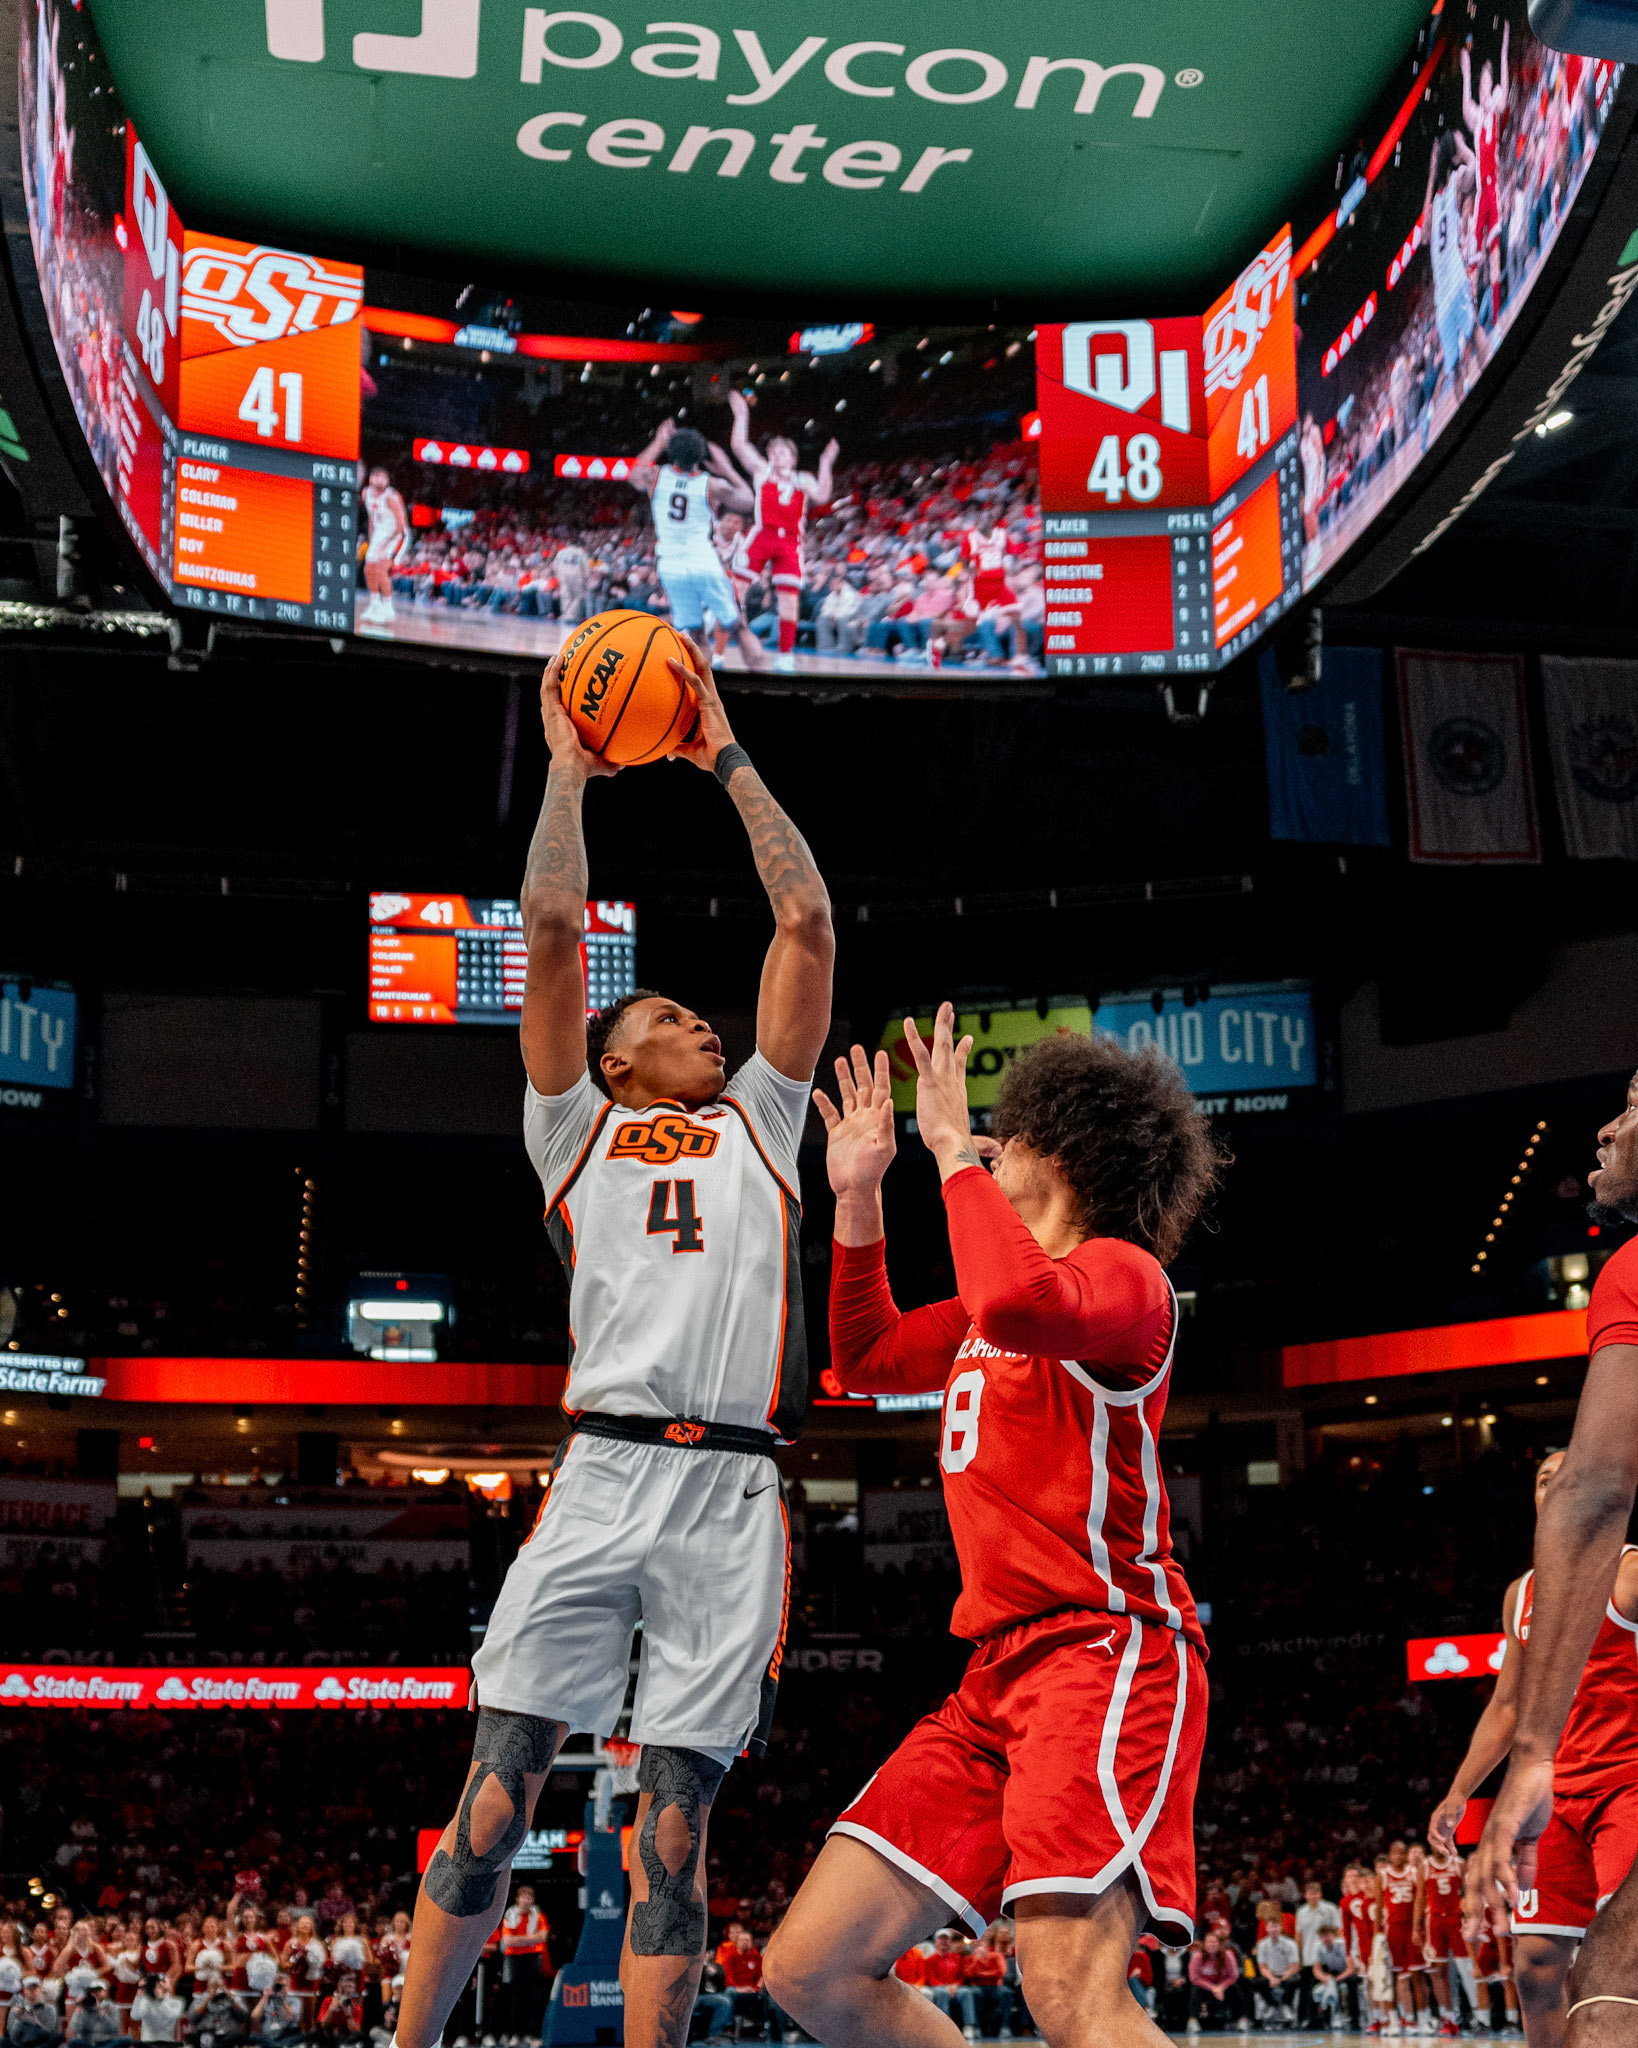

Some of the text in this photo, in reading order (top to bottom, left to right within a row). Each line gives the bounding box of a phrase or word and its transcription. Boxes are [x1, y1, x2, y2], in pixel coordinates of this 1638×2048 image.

[516, 111, 973, 192] center
[239, 367, 302, 442] 41
[1237, 374, 1270, 458] 41
[183, 438, 354, 483] PLAYER PTS FL
[1087, 433, 1163, 503] 48
[180, 488, 237, 510] COLEMAN
[181, 463, 219, 482] CLARY
[341, 491, 351, 507] 2
[668, 493, 688, 521] 9
[1045, 518, 1088, 534] PLAYER
[1167, 514, 1190, 530] PTS
[180, 512, 223, 533] MILLER
[320, 536, 329, 552] 7
[179, 537, 204, 553] ROY
[317, 560, 333, 577] 13
[208, 591, 218, 608] 3
[276, 603, 300, 620] 2ND
[318, 585, 328, 600] 2
[1178, 584, 1188, 600] 2
[1113, 656, 1122, 672] 2
[580, 648, 624, 722] NCAA
[420, 901, 453, 925] 41
[1219, 1009, 1305, 1072] CITY
[1234, 1095, 1288, 1113] NOW
[606, 1114, 721, 1165] OSU
[647, 1179, 704, 1254] 4
[940, 1368, 986, 1474] 8
[1389, 1886, 1413, 1904] 35
[1437, 1878, 1452, 1895] 5
[590, 1995, 623, 2006] BANK
